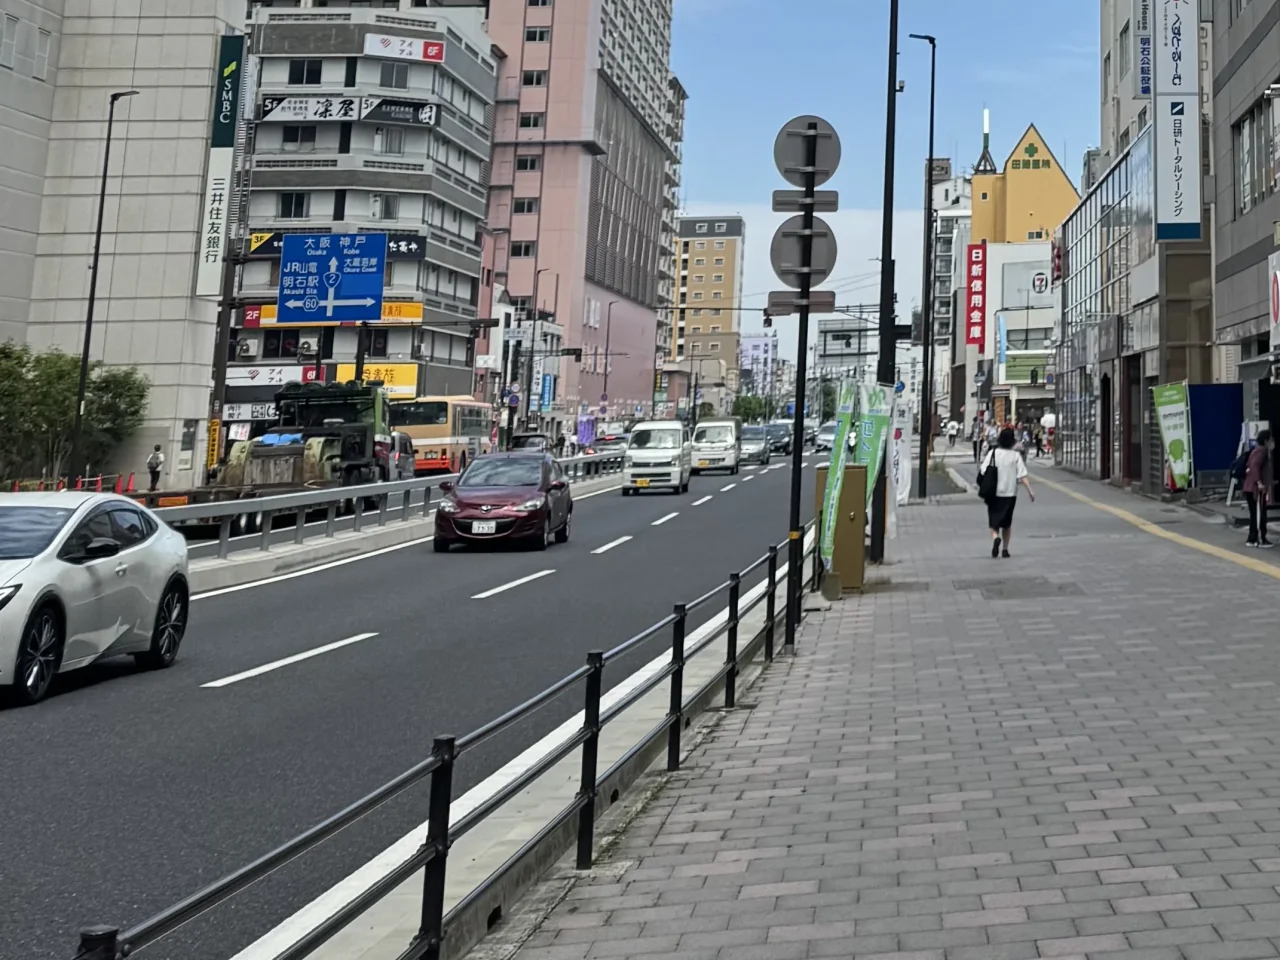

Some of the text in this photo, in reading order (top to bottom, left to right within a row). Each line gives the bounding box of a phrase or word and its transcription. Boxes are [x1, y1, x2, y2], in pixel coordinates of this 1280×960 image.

[1142, 3, 1150, 31] House
[219, 79, 233, 123] SMBC
[264, 99, 277, 110] 5F
[363, 99, 374, 110] 5F
[1173, 119, 1183, 217] 日研トータルソーシング
[204, 178, 226, 263] 三井住友銀行
[254, 235, 264, 244] 3F
[304, 237, 331, 248] 大阪
[340, 236, 366, 247] 神戸
[284, 262, 318, 274] JR山電
[283, 276, 319, 288] 明石駅
[329, 274, 336, 284] 2
[970, 249, 983, 339] 日新信用金庫
[305, 298, 317, 308] 60
[246, 311, 260, 320] 2F
